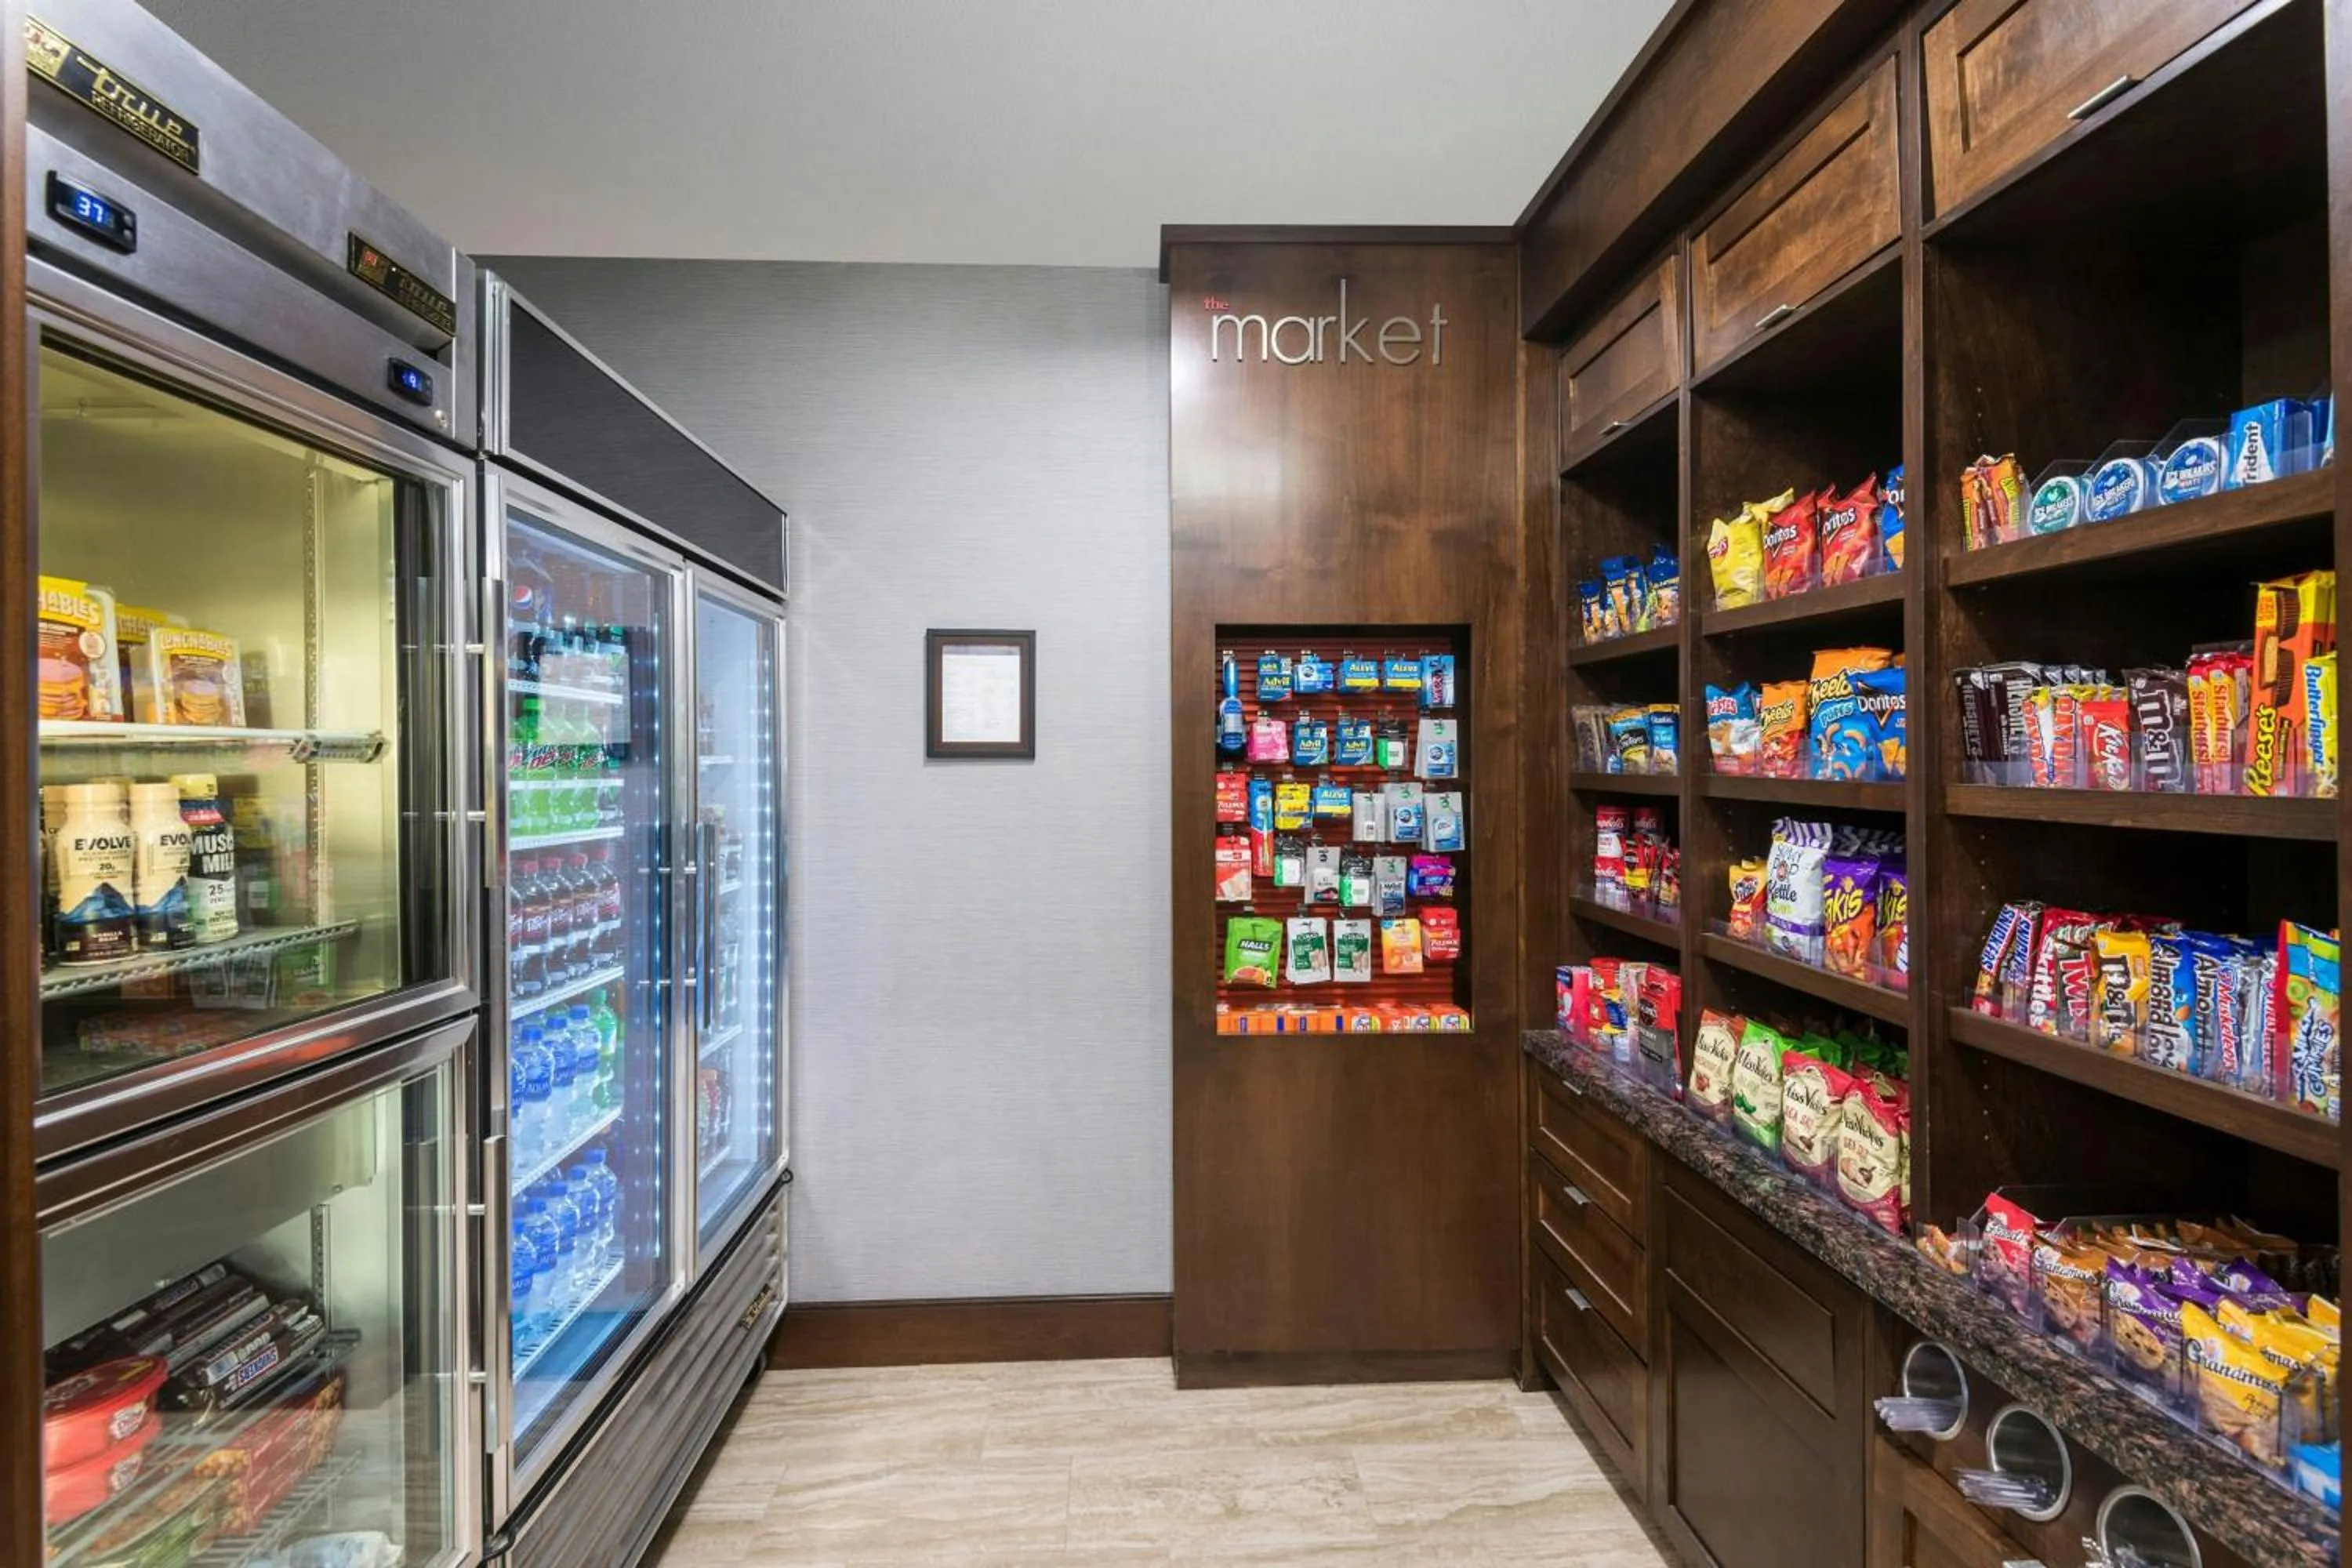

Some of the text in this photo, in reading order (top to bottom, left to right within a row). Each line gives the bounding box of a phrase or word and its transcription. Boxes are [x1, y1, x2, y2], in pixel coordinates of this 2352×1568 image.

[78, 195, 104, 223] 37
[1203, 296, 1230, 311] the
[1211, 278, 1448, 365] market
[2241, 423, 2260, 485] rident
[1263, 676, 1290, 688] Advil
[1857, 694, 1906, 713] Doritos
[2305, 666, 2326, 767] Butterfinger
[74, 836, 132, 851] EVOLVE
[1240, 940, 1270, 951] HALLS
[2307, 1021, 2334, 1097] GUMMIES
